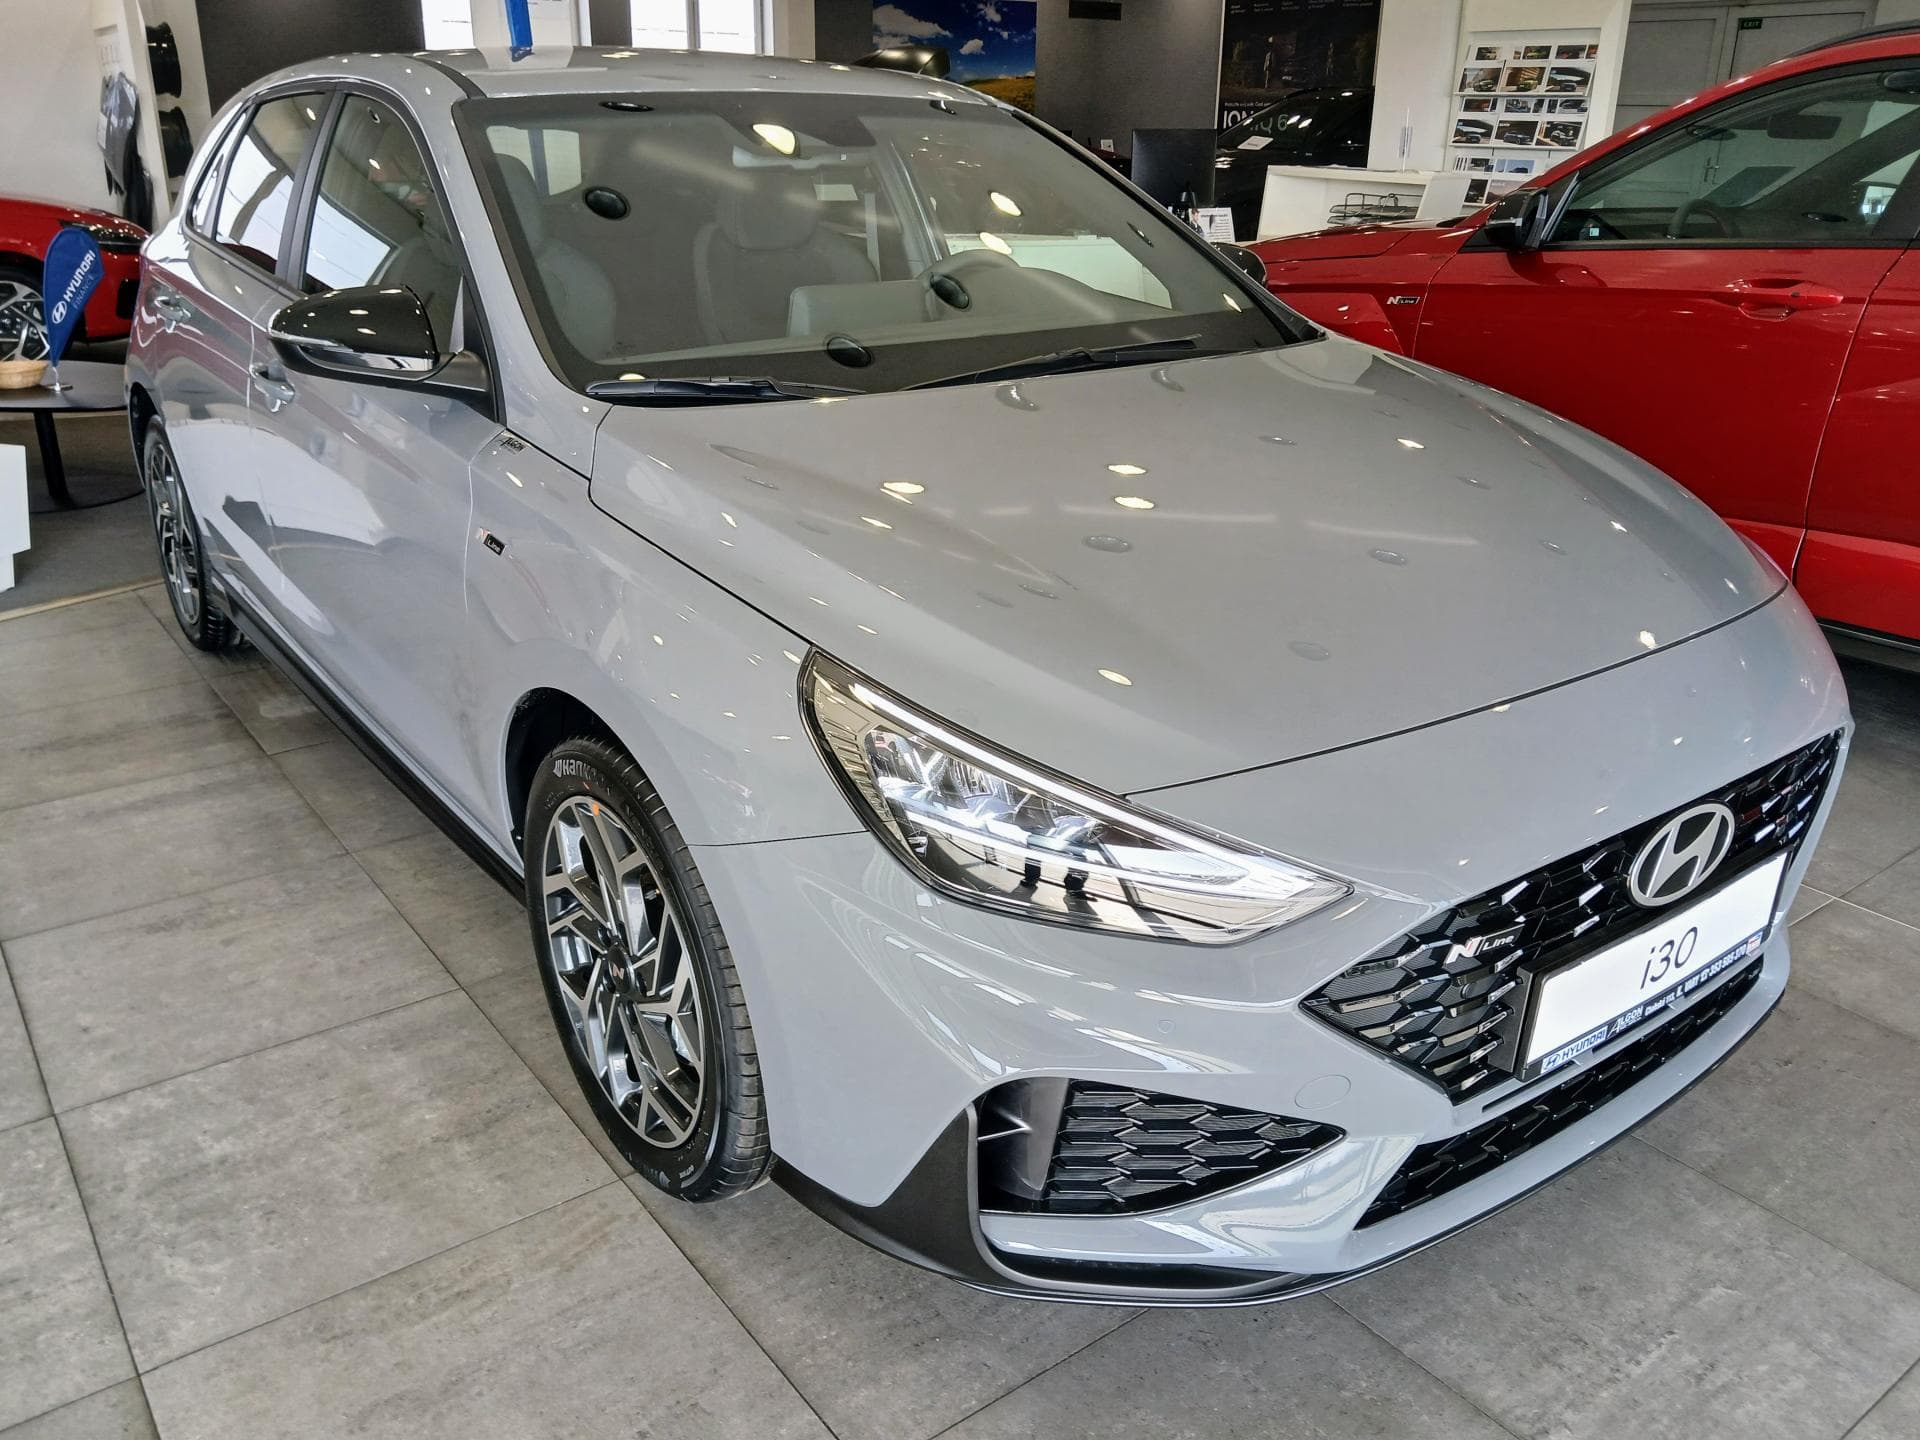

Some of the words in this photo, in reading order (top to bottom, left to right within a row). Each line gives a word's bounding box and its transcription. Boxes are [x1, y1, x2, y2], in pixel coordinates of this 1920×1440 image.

[63, 249, 96, 302] HYUNDAI
[1482, 935, 1515, 951] Line
[1640, 926, 1698, 990] i30
[1562, 1029, 1607, 1060] HYUNDAI
[1607, 1005, 1644, 1039] ALGON
